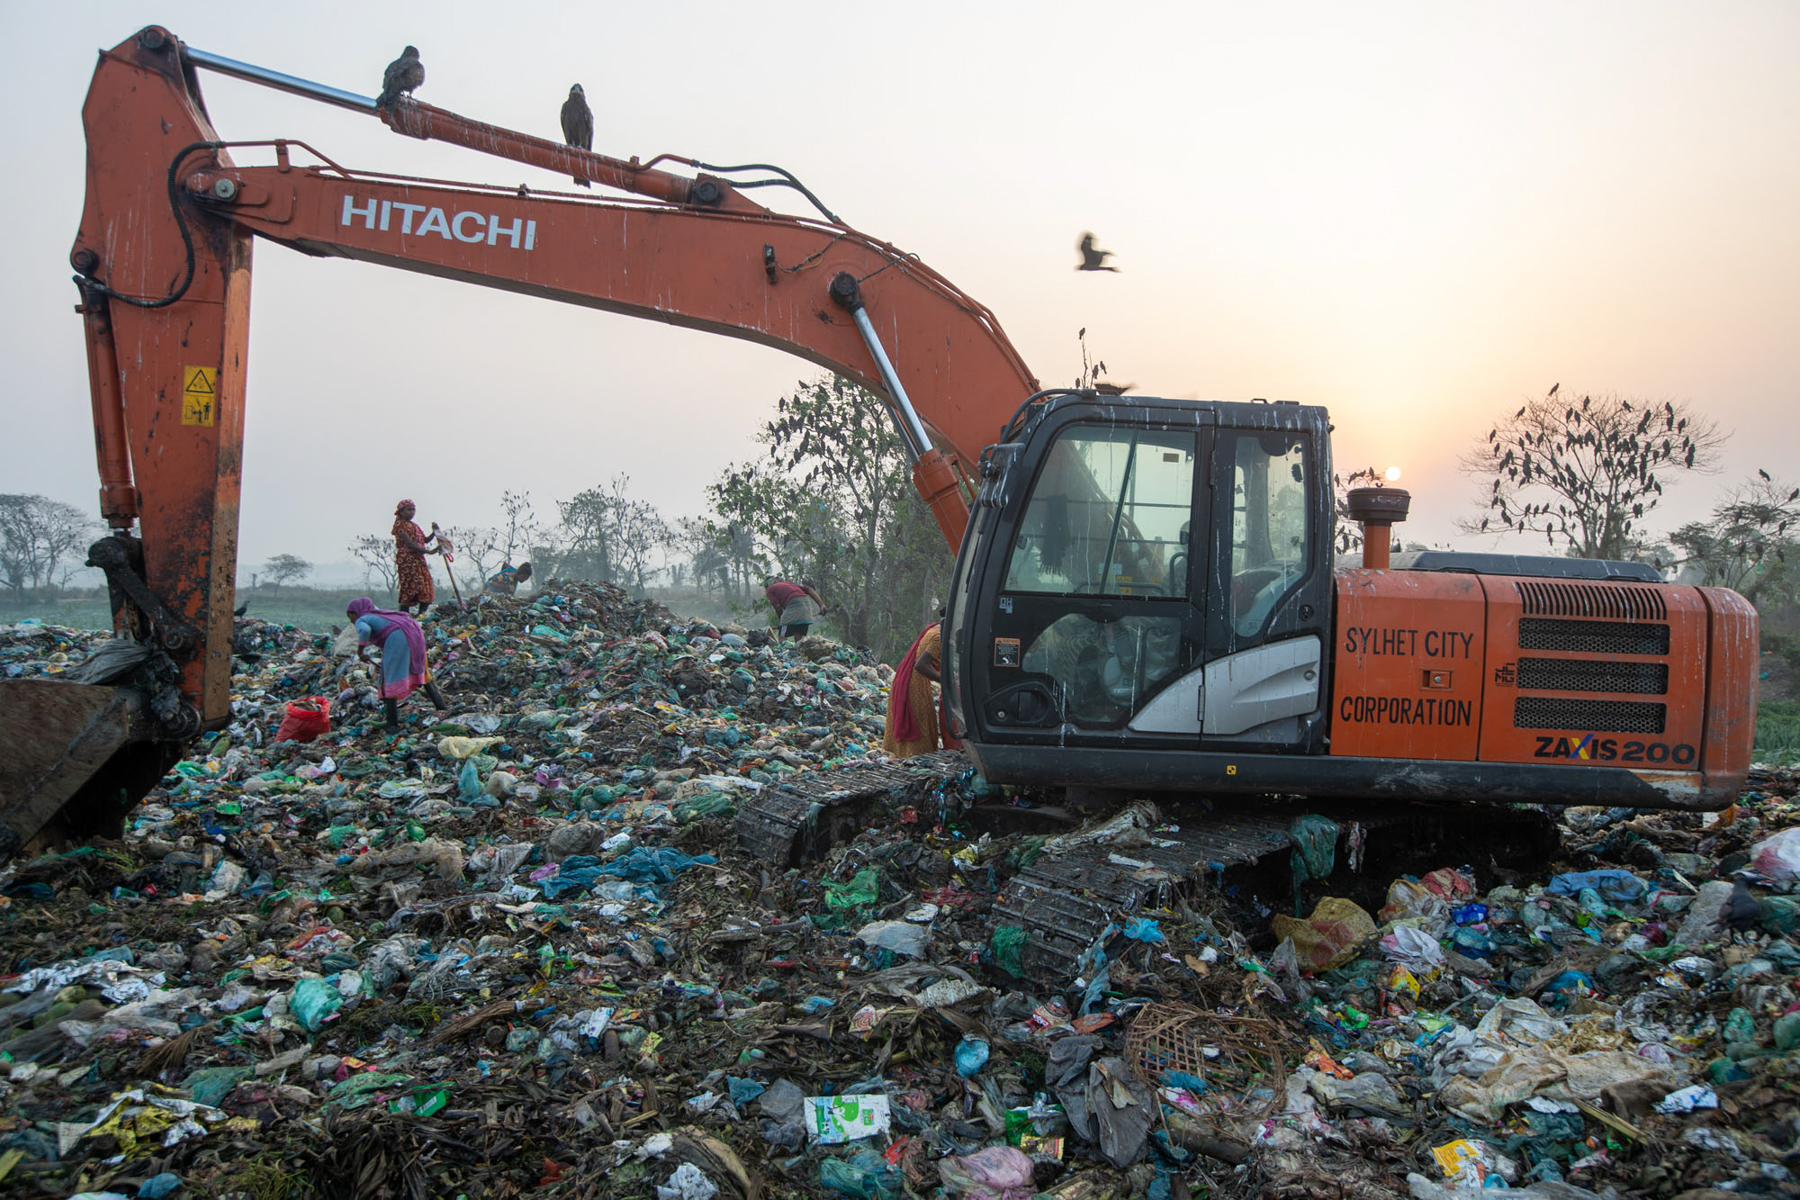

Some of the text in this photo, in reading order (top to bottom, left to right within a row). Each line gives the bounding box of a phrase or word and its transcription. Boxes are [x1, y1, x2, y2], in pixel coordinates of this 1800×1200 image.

[341, 195, 536, 250] HITACHI
[1345, 627, 1474, 659] SYLHET CITY
[1340, 696, 1472, 726] CORPORATION
[1534, 733, 1695, 764] ZAXIS 200
